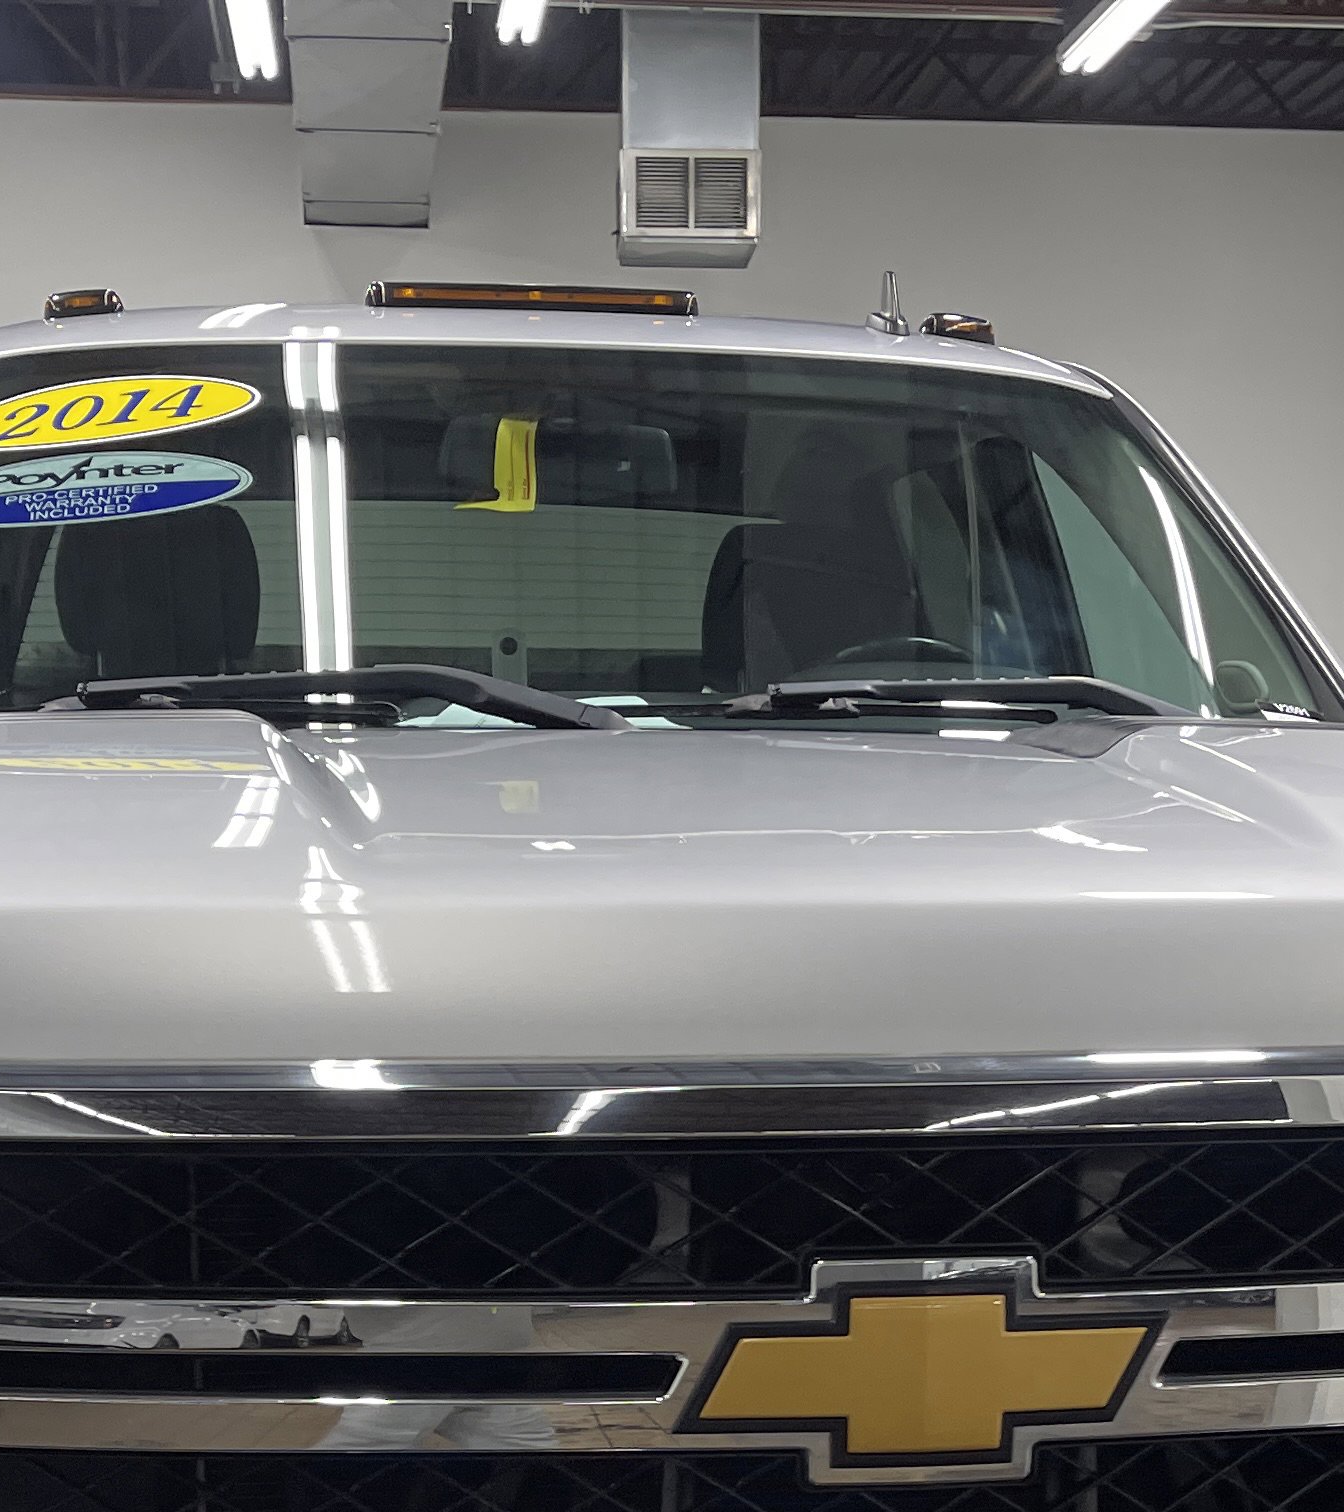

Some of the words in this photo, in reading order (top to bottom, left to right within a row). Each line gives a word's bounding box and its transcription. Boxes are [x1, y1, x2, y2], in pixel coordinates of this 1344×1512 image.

[5, 484, 158, 505] PRO-CERTIFIED
[25, 494, 137, 512] WARRANTY
[29, 504, 131, 521] INCLUDED
